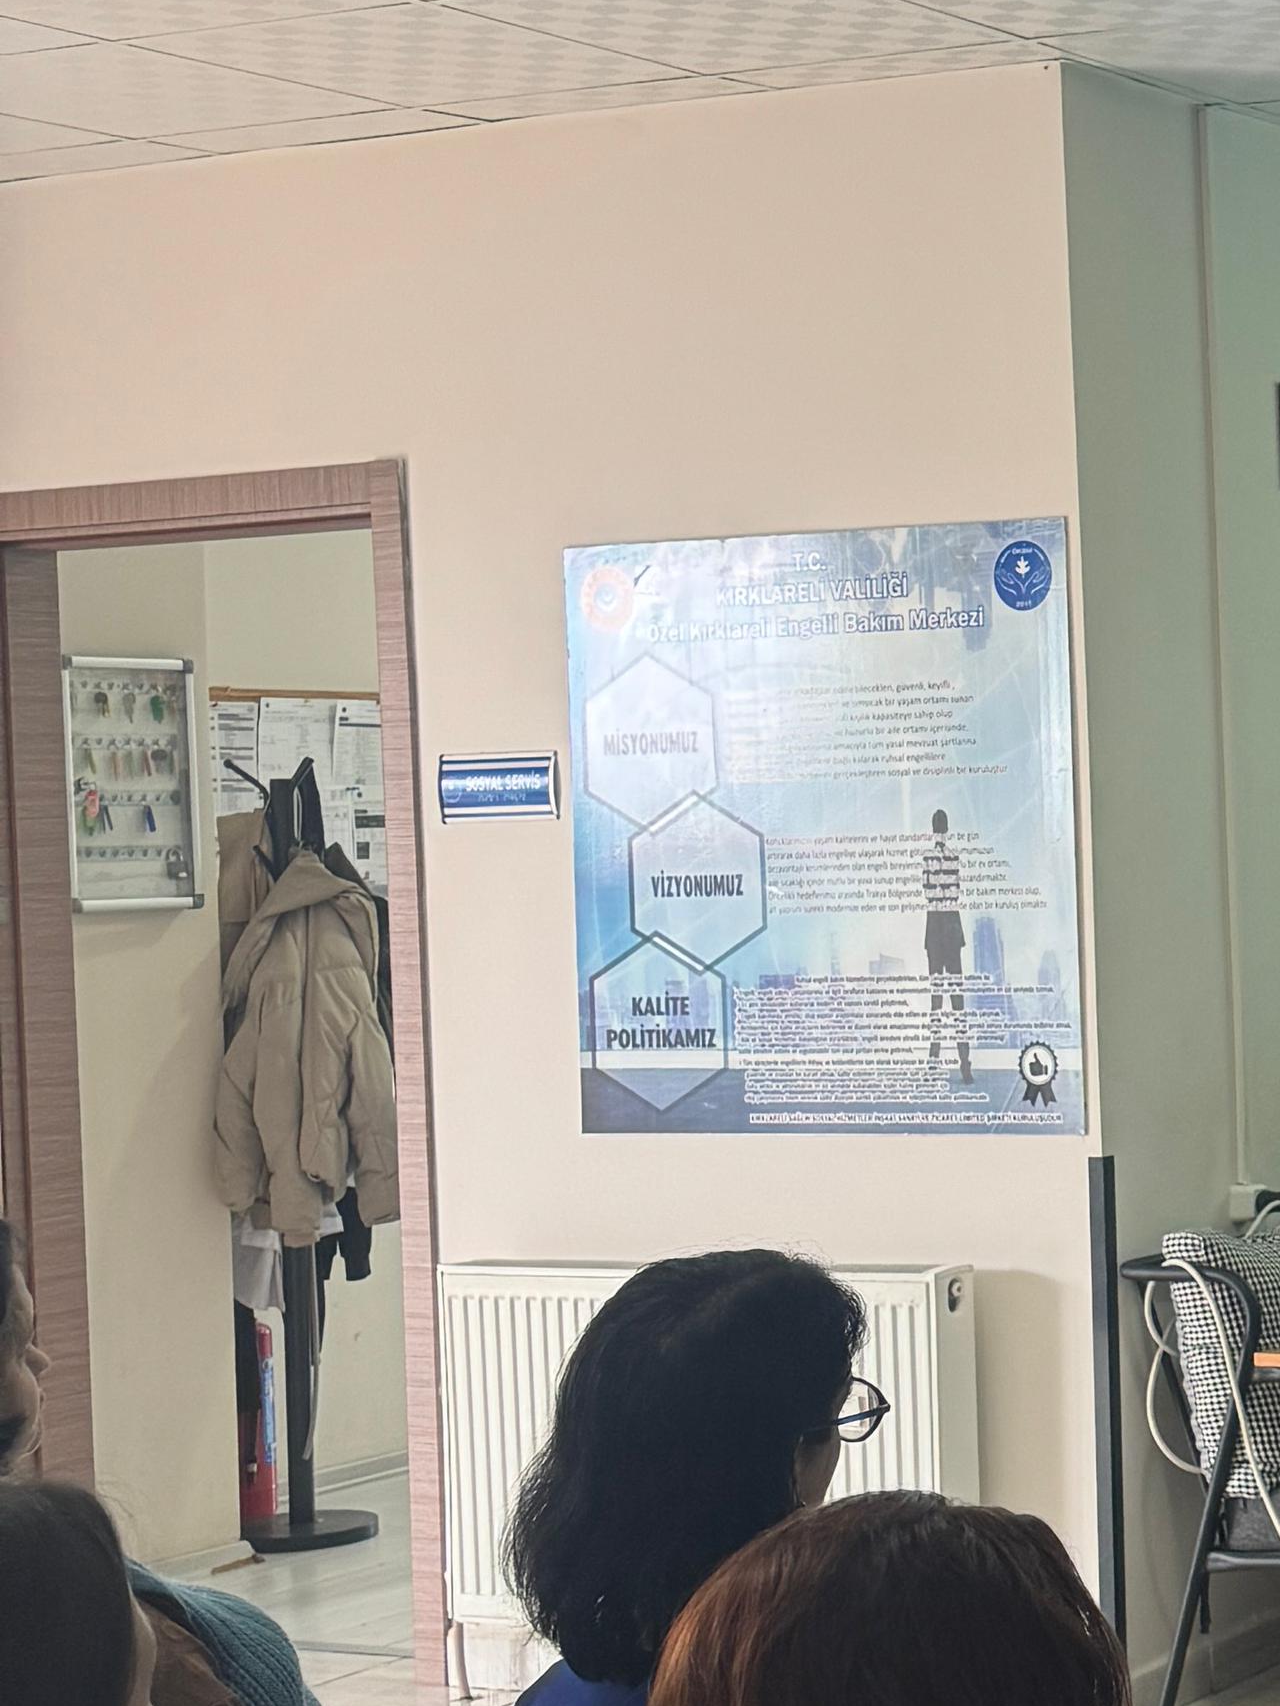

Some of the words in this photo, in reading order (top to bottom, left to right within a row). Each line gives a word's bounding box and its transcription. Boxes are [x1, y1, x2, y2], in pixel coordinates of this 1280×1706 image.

[793, 551, 827, 572] T.C.
[717, 578, 826, 607] KIRKLARELİ
[829, 572, 909, 600] VALİLİĞİ
[775, 612, 839, 641] Engelli
[843, 610, 905, 634] Bakım
[907, 604, 985, 631] Merkezi
[602, 731, 699, 756] MİSYONUMUZ
[465, 775, 504, 792] SOSYAL
[505, 769, 541, 790] SERVİS
[650, 869, 744, 898] VİZYONUMUZ
[630, 990, 691, 1017] KALİTE
[605, 1023, 717, 1050] POLİTİKAMIZ
